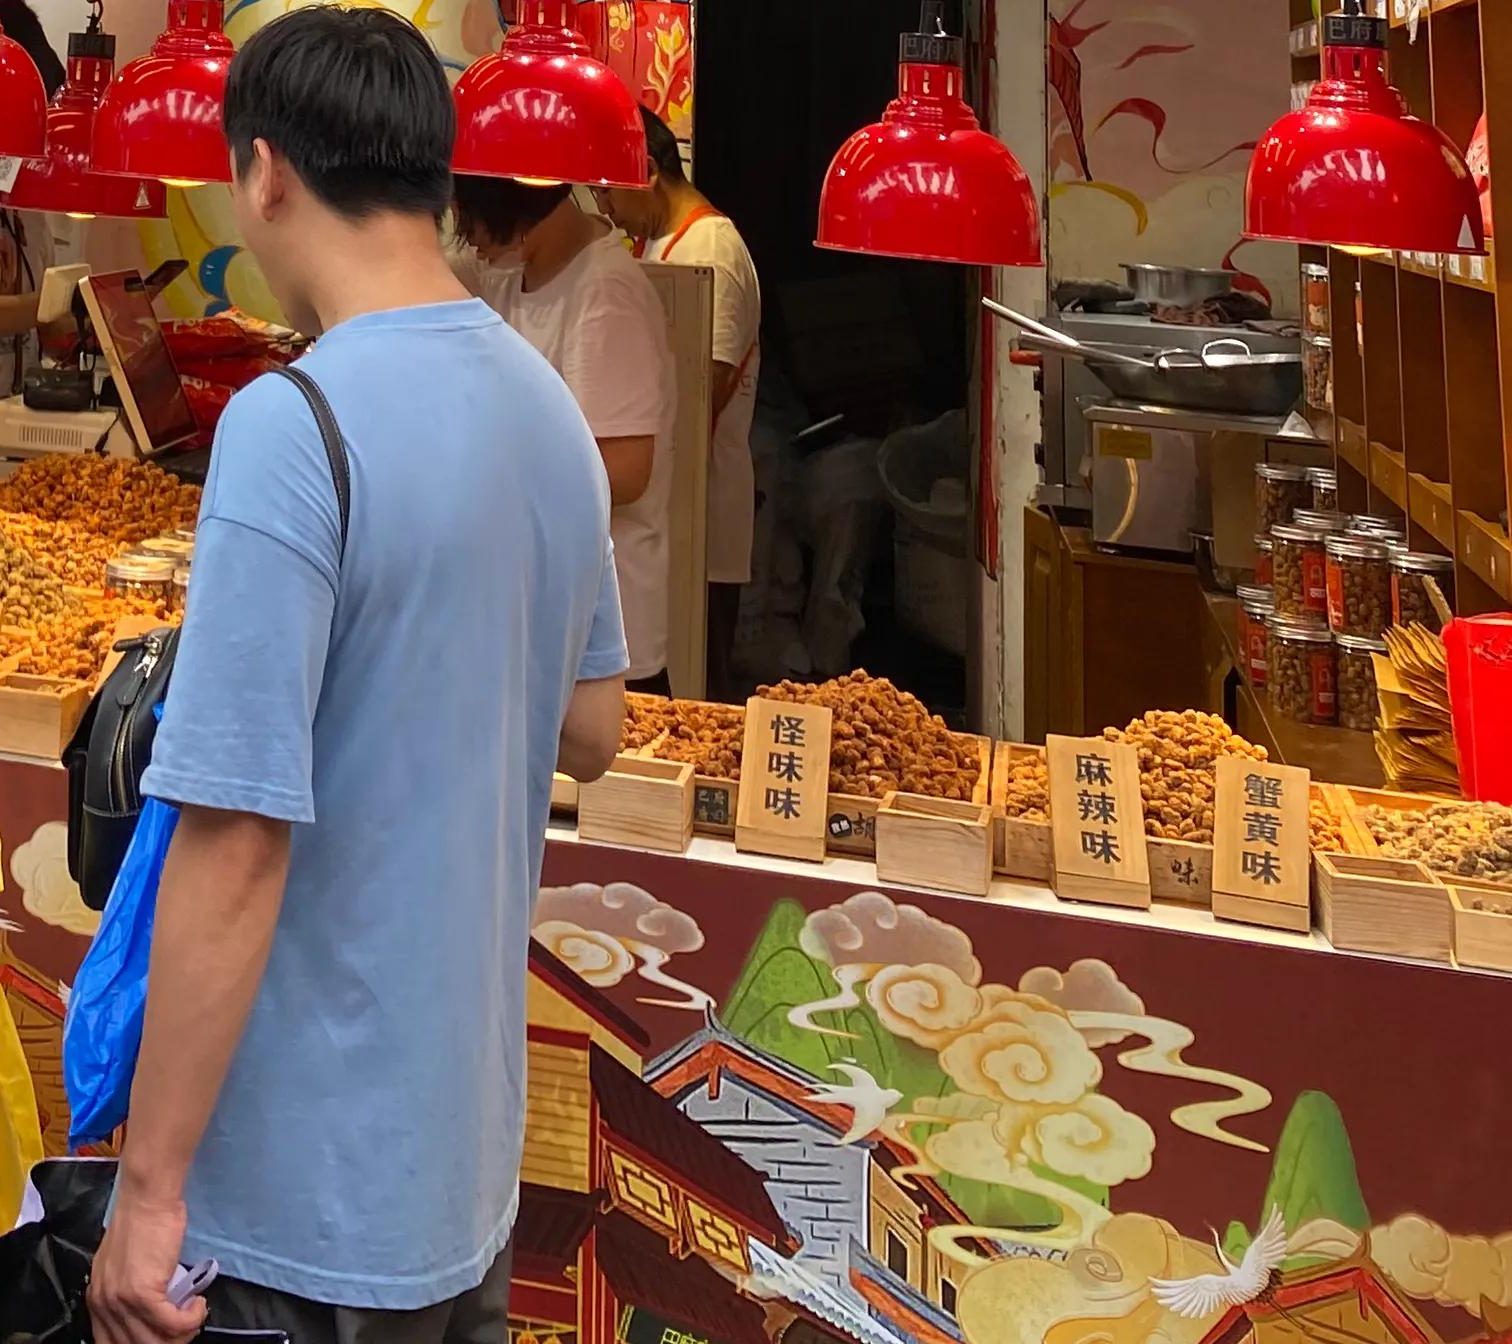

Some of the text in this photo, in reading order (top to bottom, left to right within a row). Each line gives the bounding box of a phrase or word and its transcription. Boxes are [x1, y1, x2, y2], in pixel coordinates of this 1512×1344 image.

[764, 713, 807, 820] 怪味味
[1074, 752, 1122, 865] 麻辣味
[1241, 772, 1283, 886] 蟹黄味
